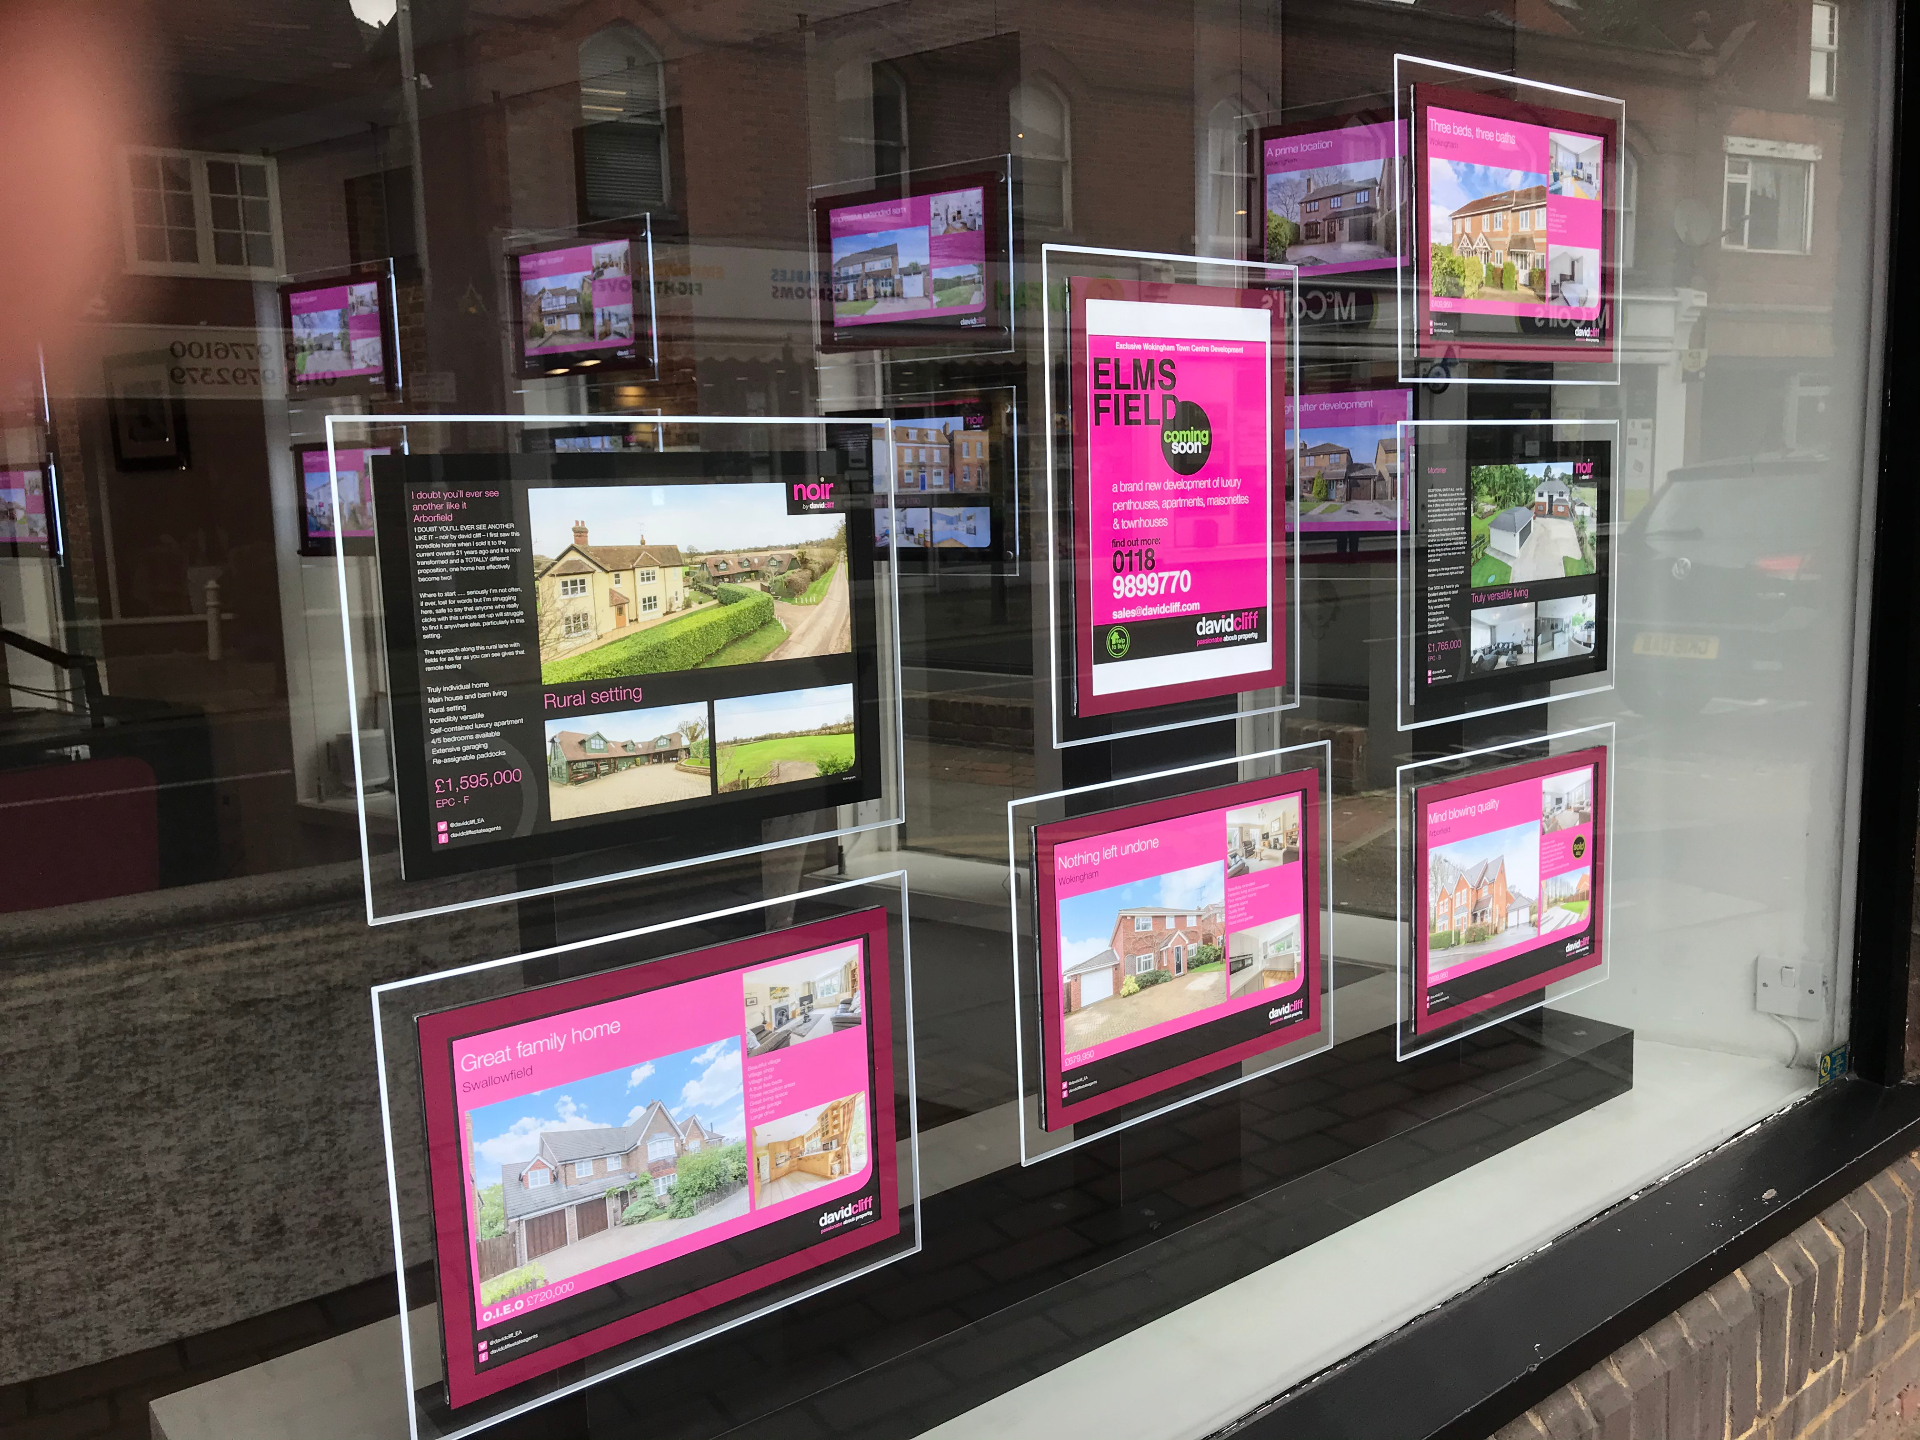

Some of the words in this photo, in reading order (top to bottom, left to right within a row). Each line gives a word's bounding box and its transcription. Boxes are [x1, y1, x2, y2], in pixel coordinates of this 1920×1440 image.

[1429, 118, 1451, 134] Three
[1453, 122, 1473, 139] beds,
[1476, 127, 1494, 141] three
[1496, 130, 1515, 144] baths
[1267, 148, 1273, 157] A
[1275, 146, 1298, 157] prime
[1301, 141, 1332, 152] location
[1575, 327, 1599, 337] davidcliff
[1116, 342, 1141, 350] Exclusive
[1143, 343, 1175, 352] Wokingham
[1211, 346, 1243, 354] Development
[1094, 357, 1176, 390] ELMS
[1094, 394, 1179, 426] FIELD
[1299, 403, 1317, 411] after
[1319, 399, 1373, 411] development
[1164, 427, 1209, 445] coming
[1172, 442, 1202, 454] soon
[1576, 459, 1593, 473] noir
[794, 477, 833, 500] noir
[1112, 483, 1118, 492] a
[1120, 481, 1143, 491] brand
[1145, 481, 1161, 490] new
[1163, 478, 1211, 491] development
[1212, 478, 1219, 488] of
[1221, 477, 1242, 489] luxury
[412, 491, 414, 499] I
[417, 490, 441, 499] doubt
[443, 490, 463, 500] you'll
[413, 502, 444, 511] another
[446, 502, 460, 510] like
[462, 501, 467, 509] it
[1113, 501, 1160, 513] penthouses,
[1162, 497, 1205, 510] apartments,
[1207, 494, 1249, 506] maisonettes
[413, 513, 453, 522] Arborfield
[1113, 518, 1119, 530] &
[1121, 517, 1168, 529] townhouses
[1112, 538, 1125, 548] find
[1127, 538, 1138, 547] out
[1141, 538, 1160, 546] more:
[1113, 548, 1155, 573] 0118
[1113, 570, 1191, 599] 9899770
[1471, 593, 1485, 604] Truly
[1487, 590, 1512, 601] versatile
[1514, 588, 1528, 598] living
[1113, 602, 1200, 619] sales@davidcliff.com
[1196, 611, 1258, 636] davidcliff
[1196, 637, 1222, 647] passionate
[1238, 632, 1258, 641] property
[443, 683, 470, 692] individual
[544, 690, 585, 709] Rural
[591, 686, 642, 703] setting
[430, 716, 458, 724] Incredibly
[460, 712, 484, 720] versatile
[430, 724, 473, 734] Self-contained
[475, 722, 492, 730] luxury
[494, 718, 523, 727] apartment
[443, 734, 473, 743] bedrooms
[475, 731, 500, 739] available
[432, 746, 460, 754] Extensive
[462, 742, 488, 752] garaging
[433, 754, 475, 764] Re-assignable
[477, 750, 506, 759] paddocks
[434, 768, 522, 794] £1,595,000
[436, 798, 455, 808] EPC
[464, 796, 469, 804] F
[1429, 810, 1447, 824] Mind
[1449, 805, 1475, 820] blowing
[1478, 799, 1499, 814] quality
[1058, 850, 1100, 870] Nothing
[1102, 840, 1117, 860] left
[1120, 837, 1160, 856] undone
[1059, 870, 1099, 886] Wokingham
[1566, 936, 1590, 952] davidcliff
[1269, 998, 1303, 1019] davidcliff
[461, 1045, 511, 1072] Great
[516, 1033, 566, 1059] family
[572, 1020, 620, 1044] home
[463, 1066, 533, 1093] Swallowfield
[819, 1196, 872, 1226] davidcliff
[483, 1300, 524, 1322] O.I.E.O
[527, 1282, 574, 1306] £720,000
